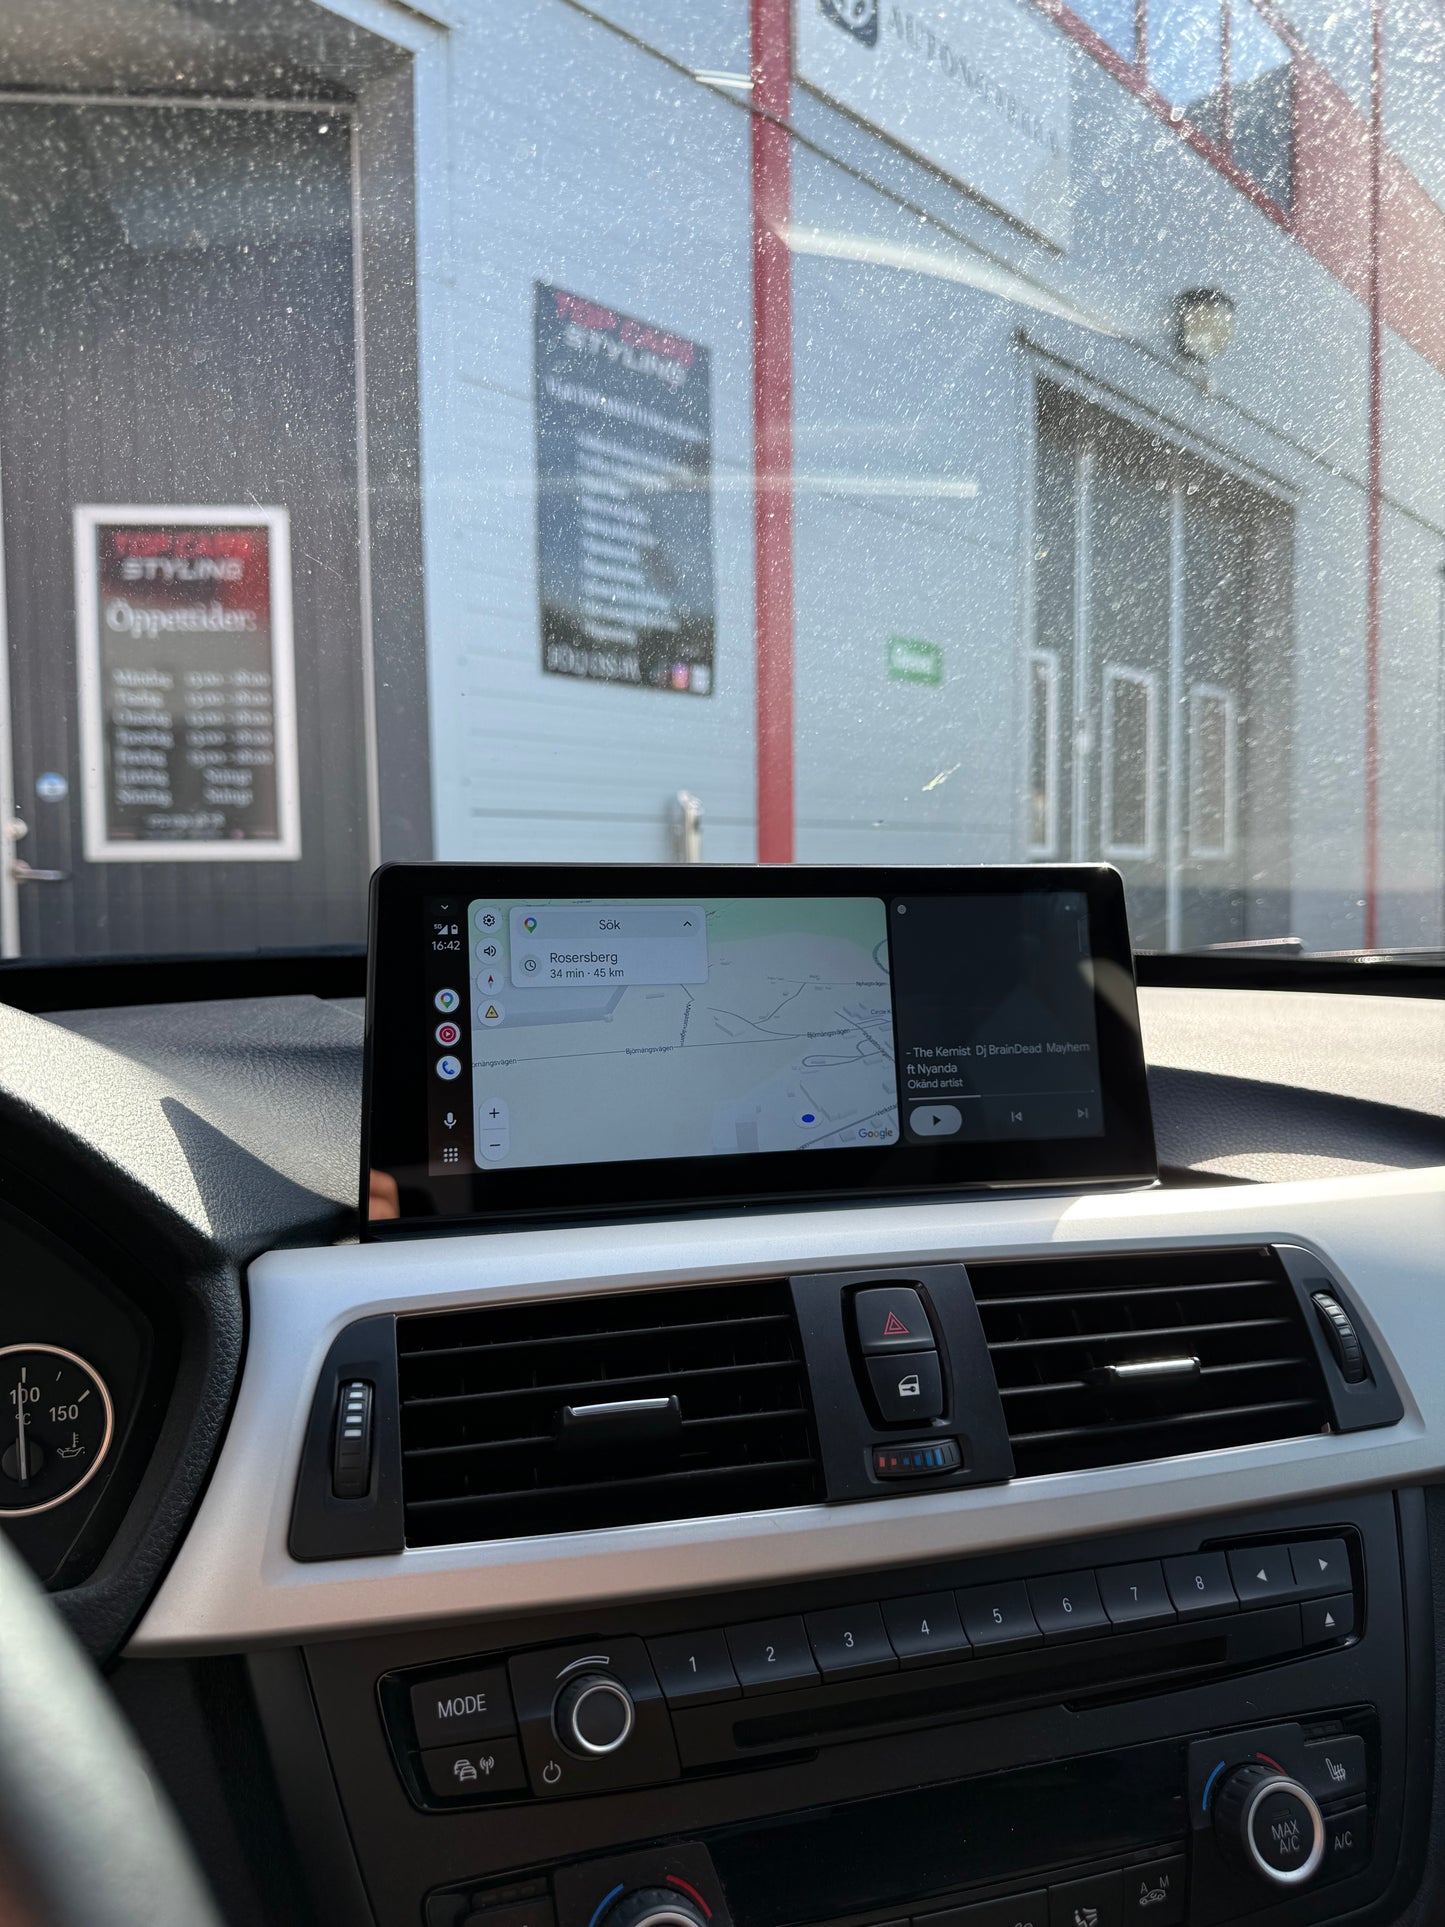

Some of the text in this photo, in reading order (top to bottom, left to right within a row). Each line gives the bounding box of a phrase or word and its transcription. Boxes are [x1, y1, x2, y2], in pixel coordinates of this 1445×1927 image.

[599, 919, 621, 931] Sök
[431, 940, 461, 951] 16:42
[550, 952, 618, 965] Rosersberg
[550, 967, 624, 979] 34 min 45 km
[913, 1047, 933, 1058] The
[935, 1046, 971, 1058] Kemist
[976, 1045, 987, 1057] Dj
[989, 1043, 1042, 1055] BrainDead
[1046, 1042, 1090, 1055] Mayhem
[907, 1063, 958, 1076] ft Nyanda
[940, 1078, 963, 1089] artist
[858, 1128, 893, 1139] Google
[9, 1387, 41, 1405] 100
[49, 1404, 79, 1422] 150
[1195, 1575, 1205, 1590] 8
[1130, 1586, 1139, 1602] 7
[1062, 1597, 1072, 1613] 6
[992, 1608, 1002, 1625] 5
[920, 1619, 930, 1636] 4
[844, 1631, 854, 1648] 3
[766, 1646, 776, 1663] 2
[688, 1656, 697, 1673] 1
[438, 1693, 487, 1718] MODE
[1271, 1819, 1299, 1840] MAX
[1279, 1835, 1299, 1855] A/C
[1334, 1830, 1353, 1851] A/C
[1140, 1875, 1170, 1894] A M
